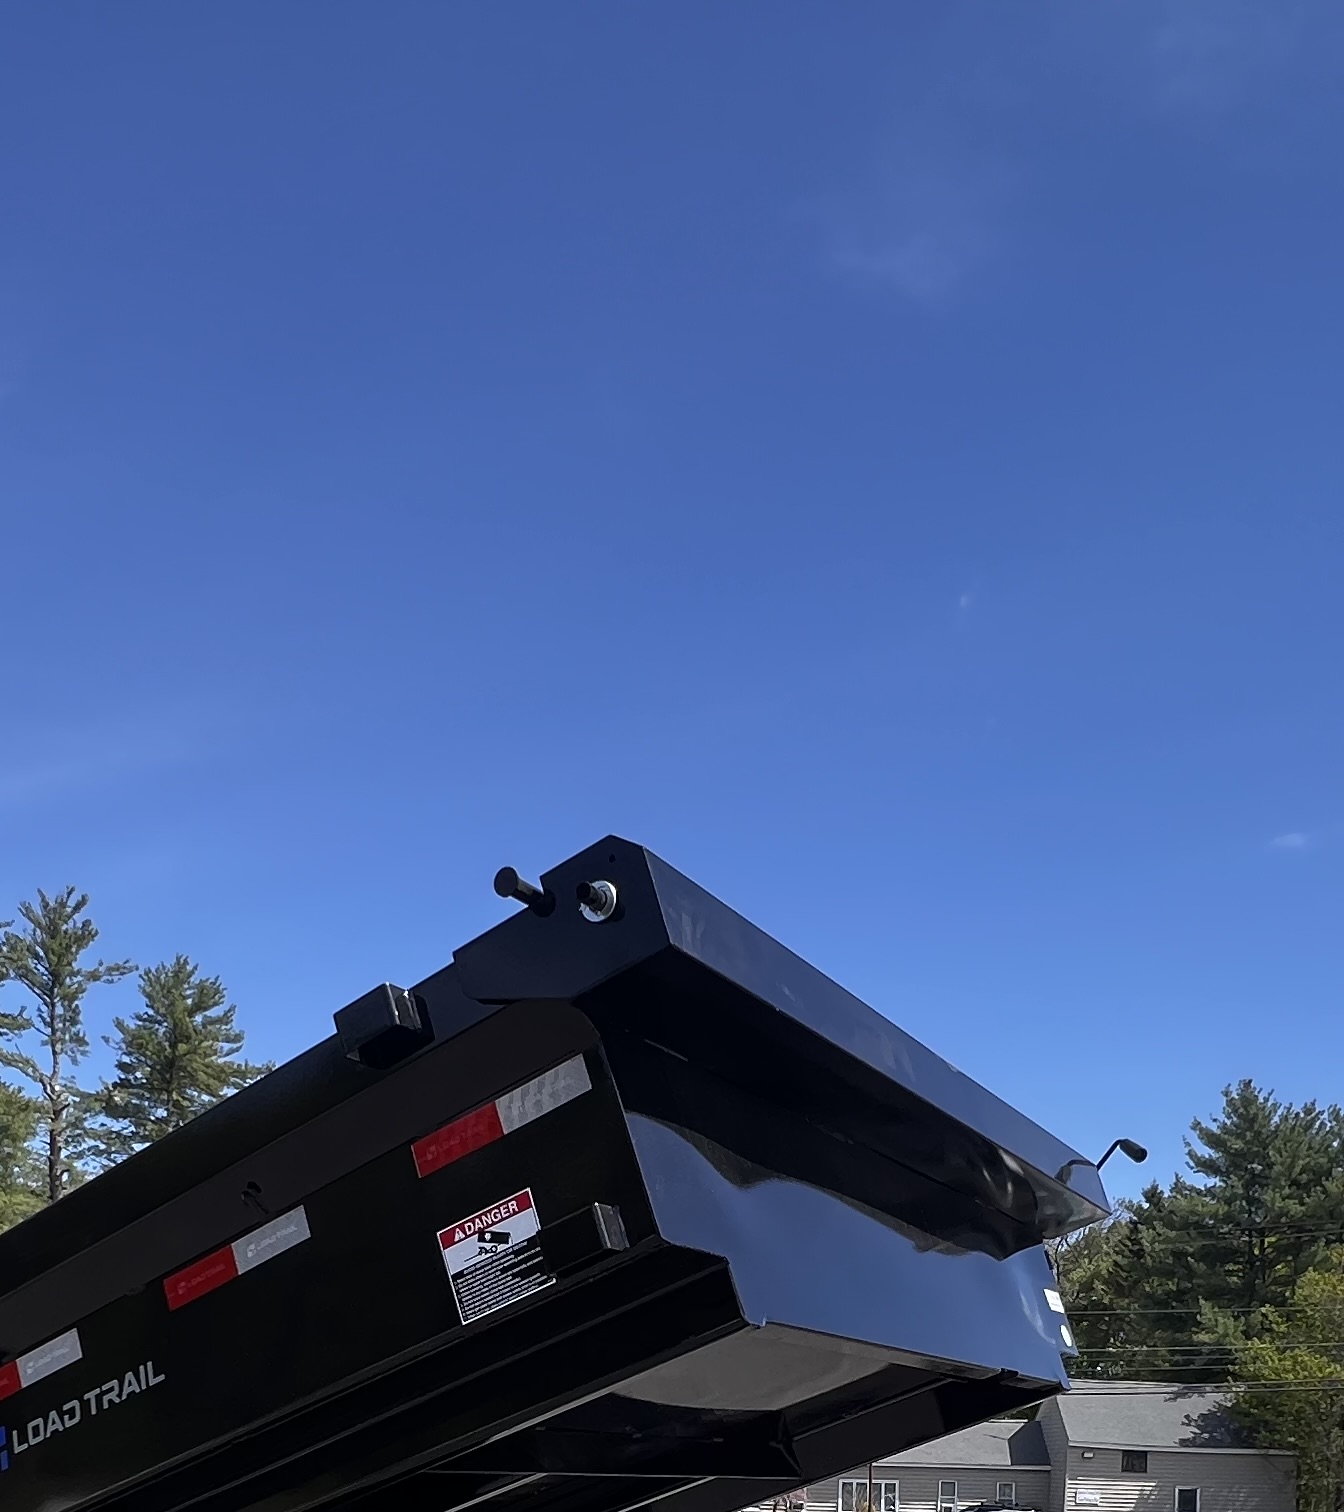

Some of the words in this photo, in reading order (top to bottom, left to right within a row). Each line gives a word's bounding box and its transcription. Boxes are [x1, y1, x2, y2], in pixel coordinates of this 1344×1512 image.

[464, 1200, 519, 1235] DANGER
[12, 1399, 81, 1454] LOAD
[83, 1360, 166, 1416] TRAIL
